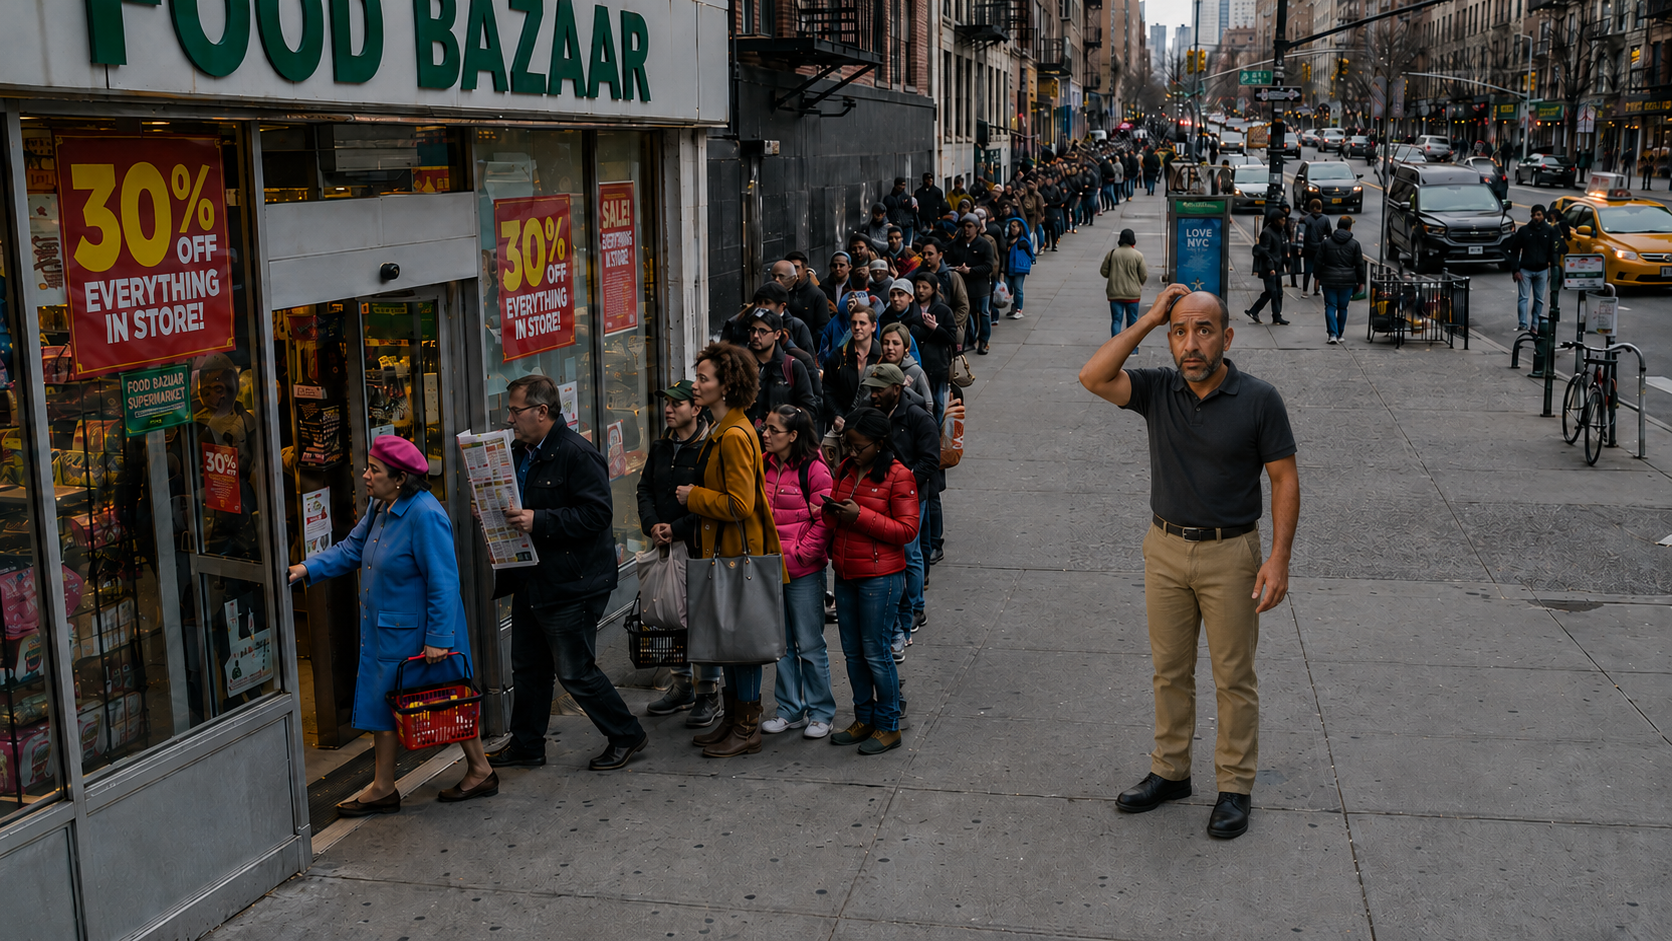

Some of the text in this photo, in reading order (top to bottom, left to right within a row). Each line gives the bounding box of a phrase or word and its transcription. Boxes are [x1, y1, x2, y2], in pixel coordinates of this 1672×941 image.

[413, 0, 651, 102] BAZAAR
[70, 161, 215, 273] 30%
[602, 199, 630, 229] SALE!
[1186, 228, 1212, 238] LOVE
[177, 234, 217, 264] OFF
[500, 216, 566, 292] 30%
[547, 262, 567, 284] OFF
[84, 268, 220, 313] EVERYTHING
[506, 286, 567, 319] EVERYTHING
[105, 302, 205, 344] IN STORE!
[515, 311, 561, 340] IN STORE!
[127, 378, 150, 394] FOOD
[127, 386, 185, 410] SUPERMARKET
[205, 451, 236, 474] 30%
